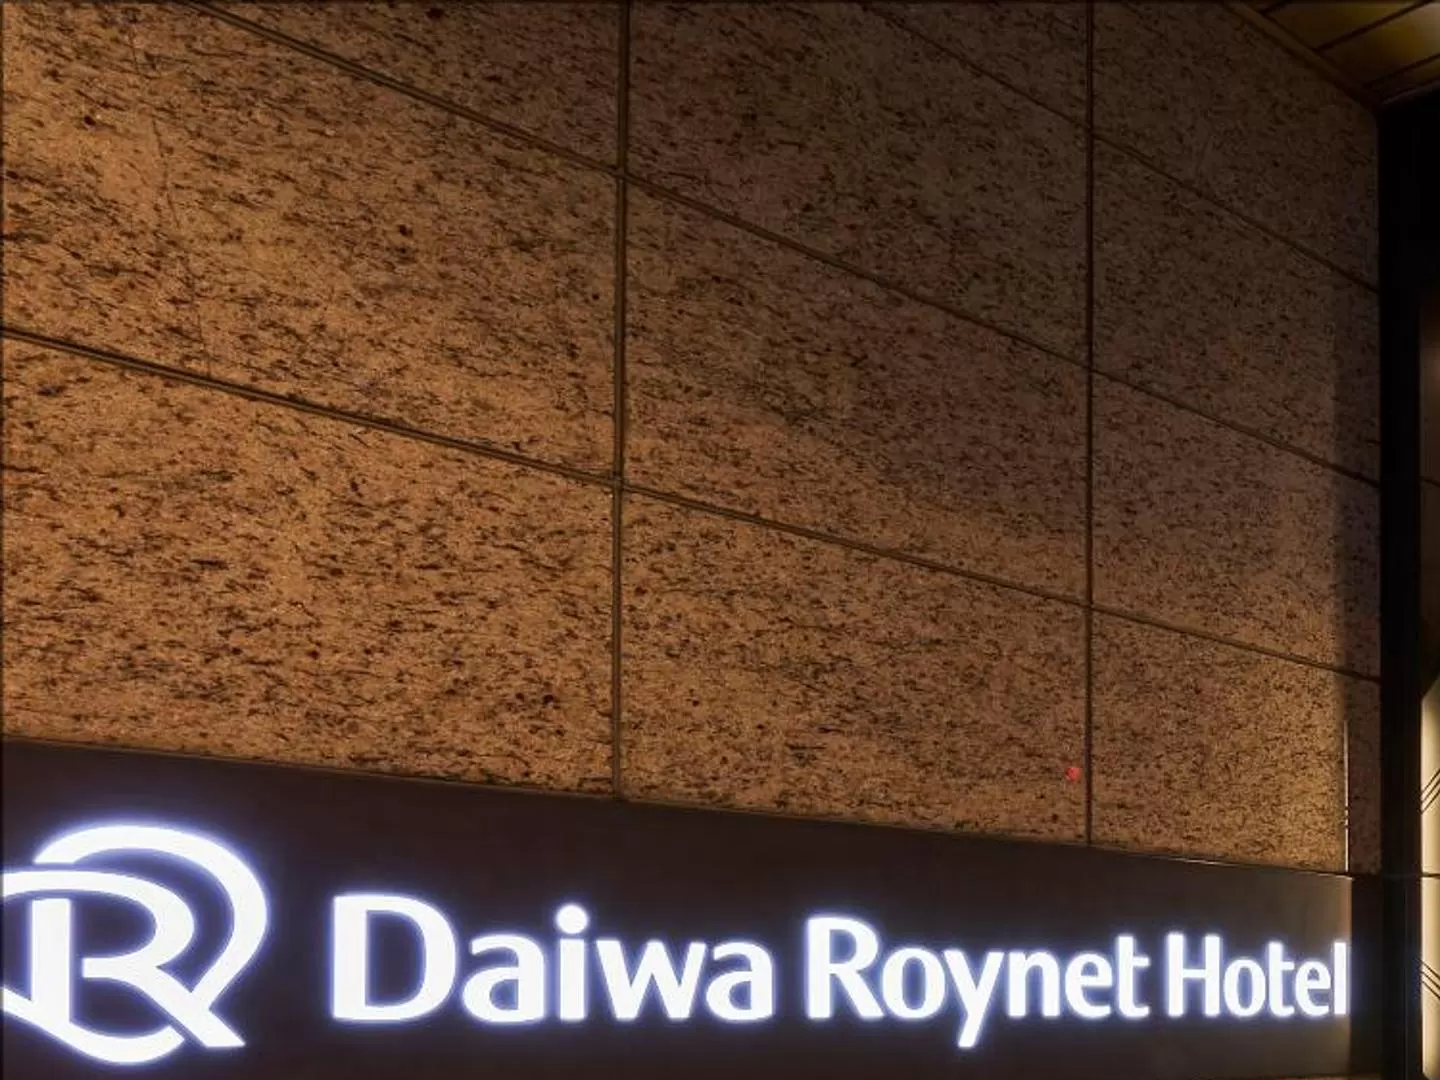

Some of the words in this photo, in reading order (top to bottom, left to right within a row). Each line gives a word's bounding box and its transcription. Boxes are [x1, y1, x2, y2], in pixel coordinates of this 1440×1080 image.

[333, 895, 772, 1022] Daiwa
[806, 915, 1149, 1048] Roynet
[1167, 933, 1347, 1017] Hotel
